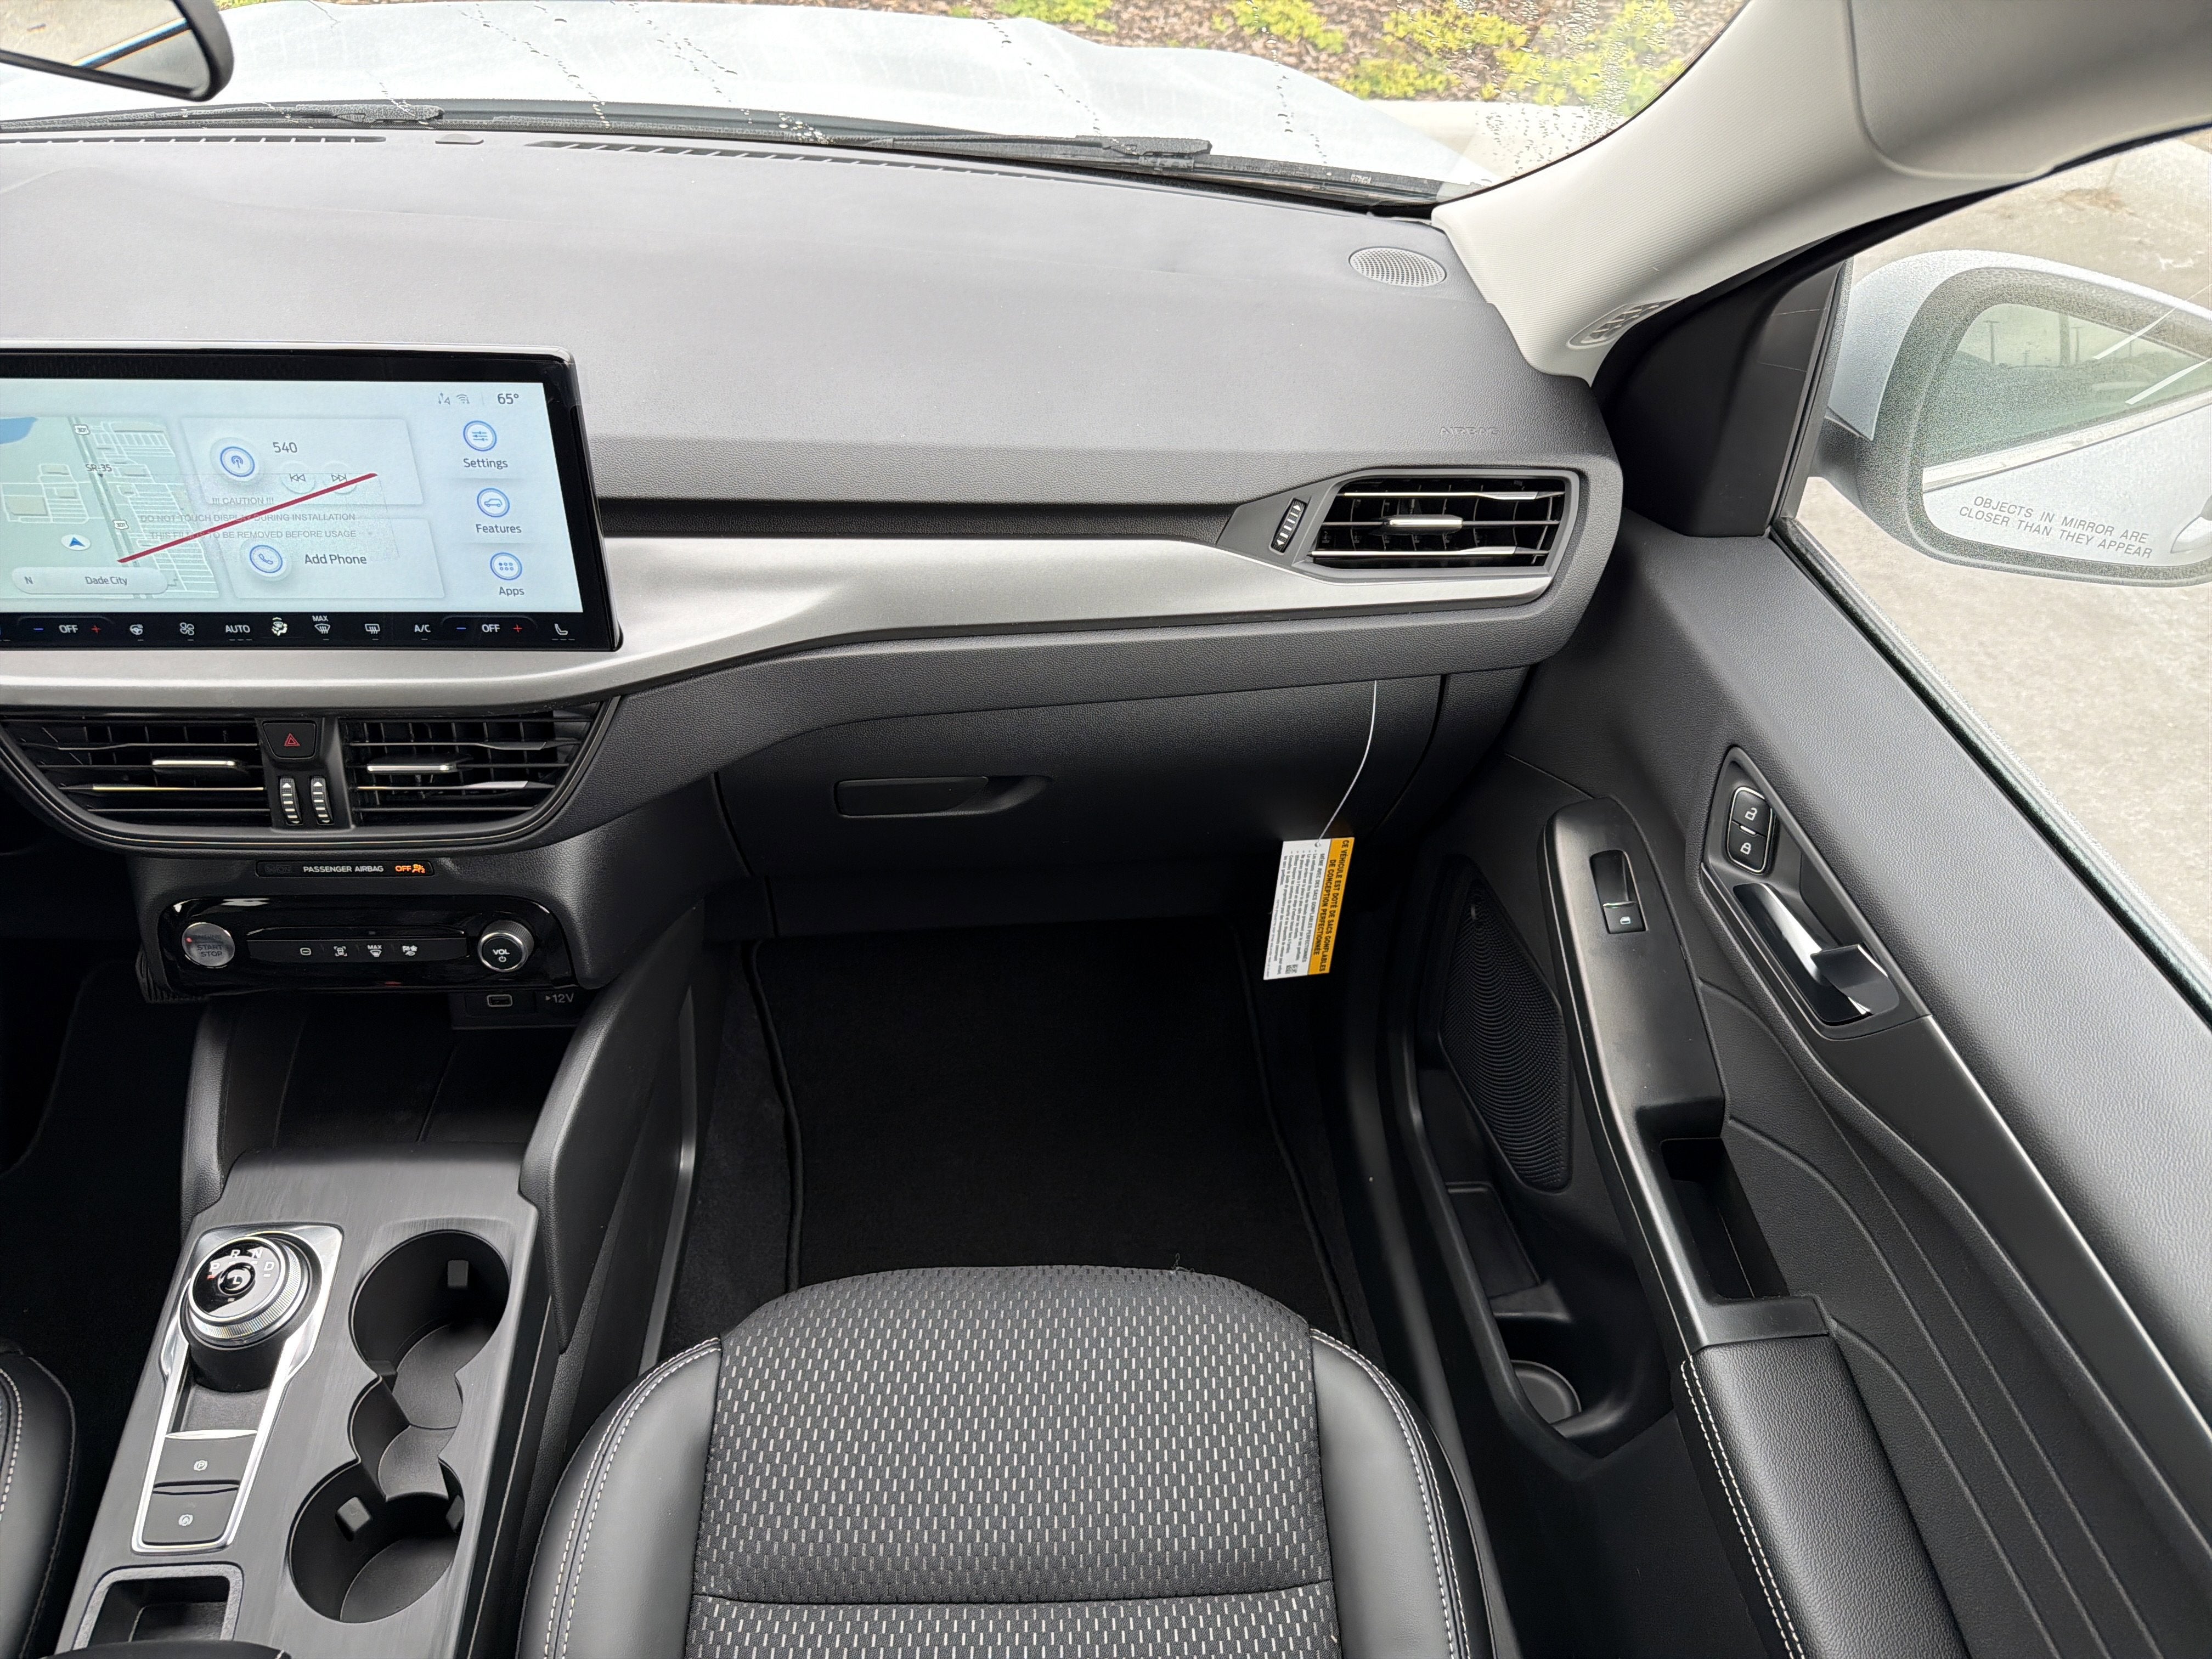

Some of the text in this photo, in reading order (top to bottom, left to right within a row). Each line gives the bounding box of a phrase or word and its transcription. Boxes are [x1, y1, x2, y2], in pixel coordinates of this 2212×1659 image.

[498, 393, 519, 404] 65°
[1440, 426, 1500, 435] AIRBAG
[273, 442, 298, 454] 540
[86, 464, 112, 472] SR-35
[464, 458, 508, 470] Settings
[293, 513, 356, 521] INSTALLATION
[1974, 496, 2149, 544] OBJECTS IN MIRROR ARE
[476, 523, 522, 534] Features
[1959, 506, 2153, 558] CLOSER THAN THEY APPEAR
[304, 554, 367, 565] Add Phone
[85, 576, 128, 586] Dade City
[499, 586, 525, 597] Apps
[59, 624, 78, 633] OFF
[225, 624, 251, 633] AUTO
[414, 623, 431, 633] A/C
[482, 624, 500, 633] OFF
[1341, 839, 1350, 848] CE
[1328, 859, 1336, 867] DE
[1322, 868, 1334, 907] CONCEPTION
[1333, 880, 1341, 891] EST
[1328, 910, 1335, 918] DE
[1325, 919, 1334, 934] SACS
[1319, 935, 1331, 972] GONFLABLES
[209, 1249, 275, 1272] P R N D
